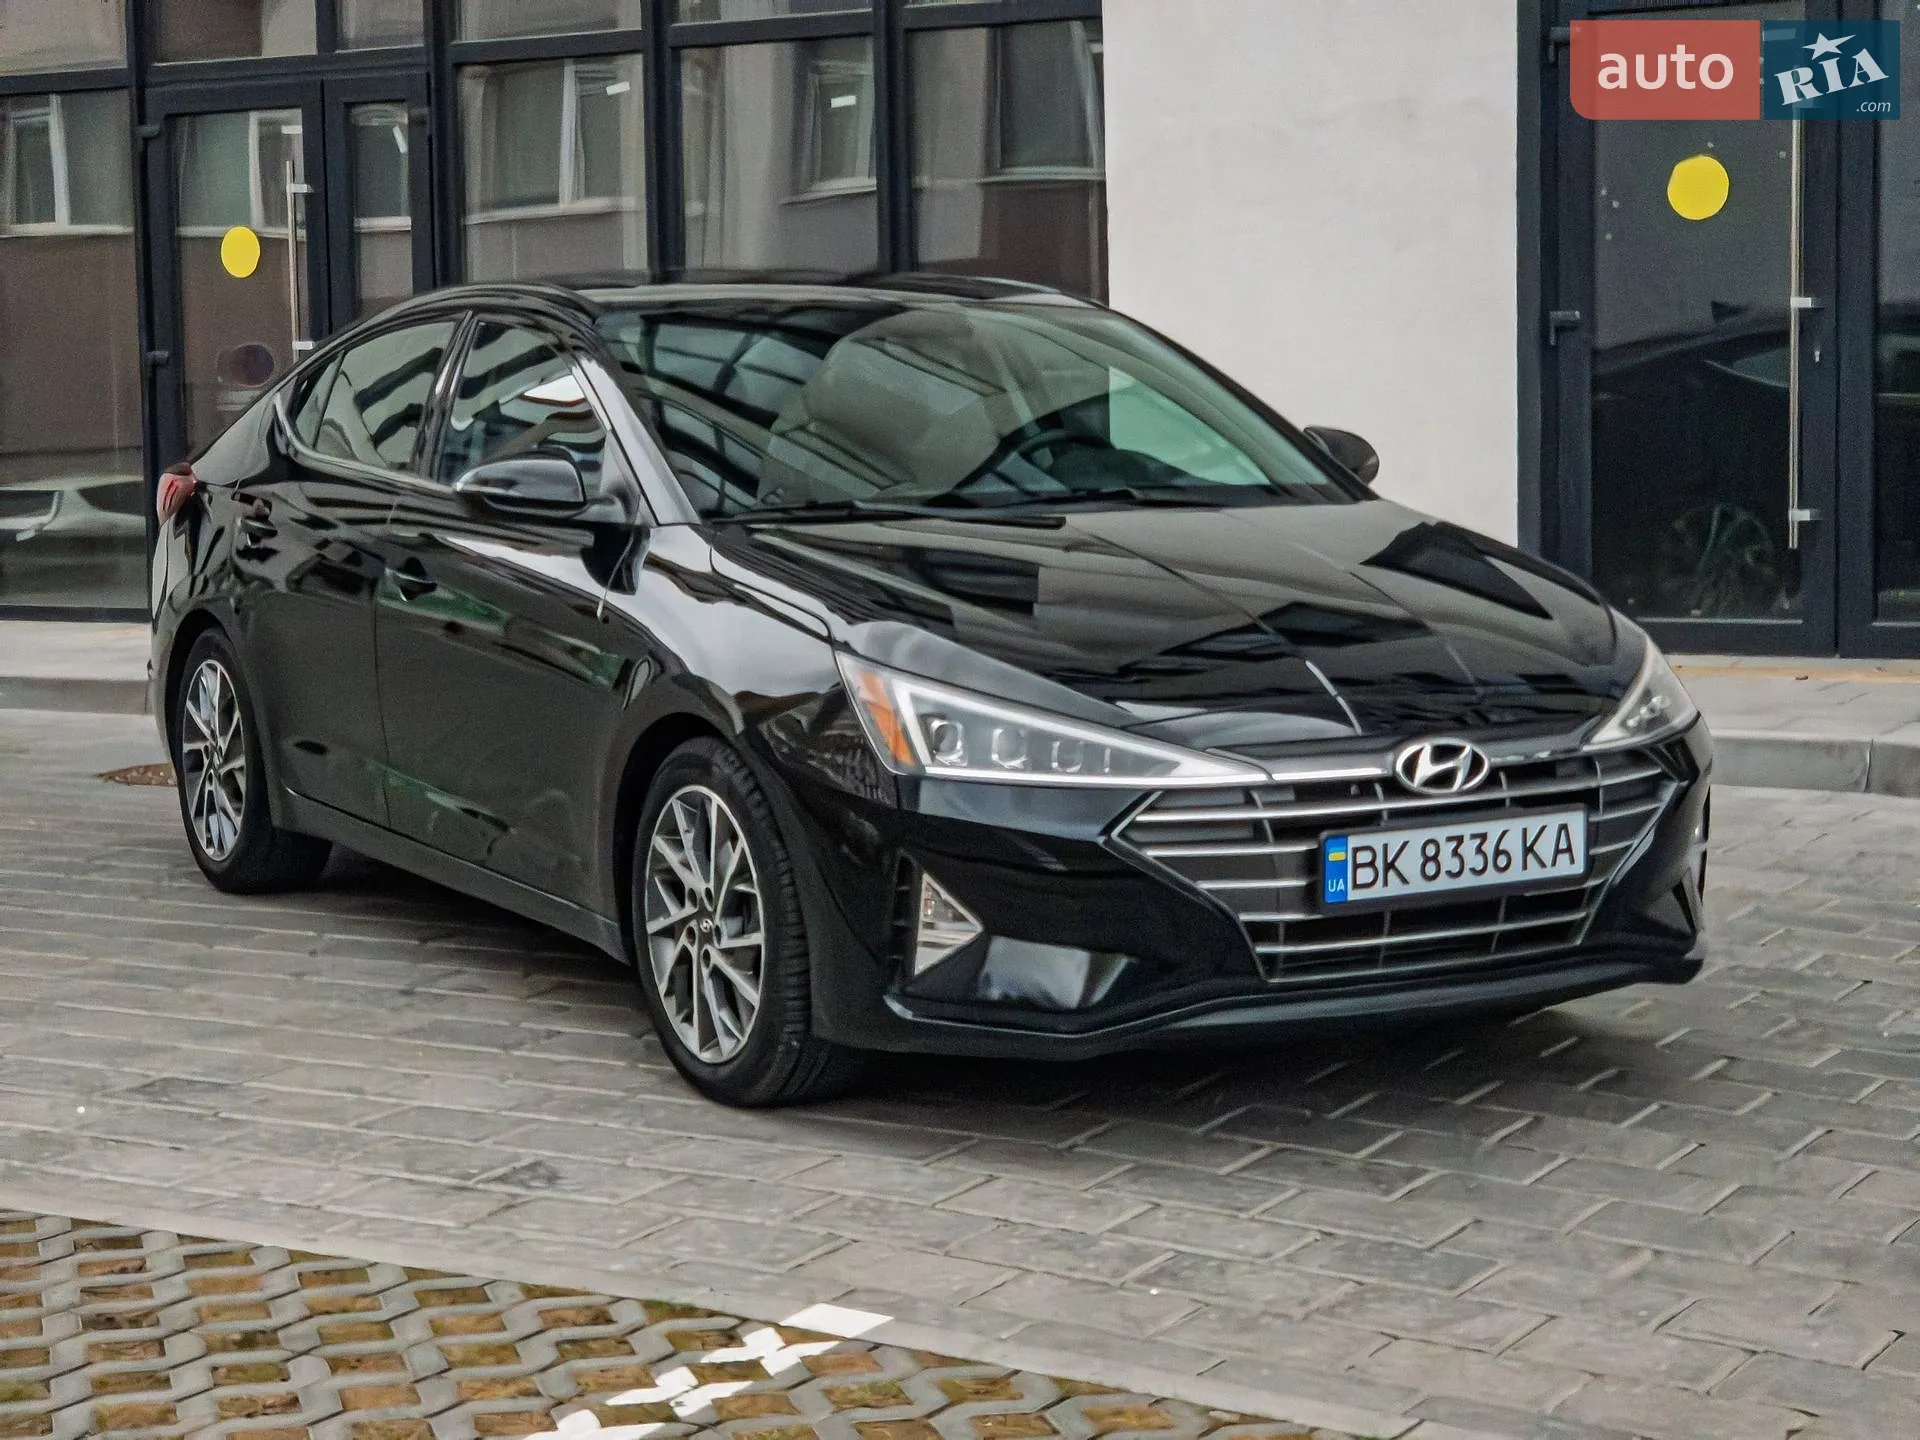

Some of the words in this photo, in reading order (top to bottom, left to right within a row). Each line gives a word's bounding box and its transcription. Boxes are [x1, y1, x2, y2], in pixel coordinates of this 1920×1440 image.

[1351, 840, 1410, 890] BK
[1419, 829, 1512, 881] 8336
[1520, 823, 1576, 871] KA
[1328, 879, 1345, 892] UA
